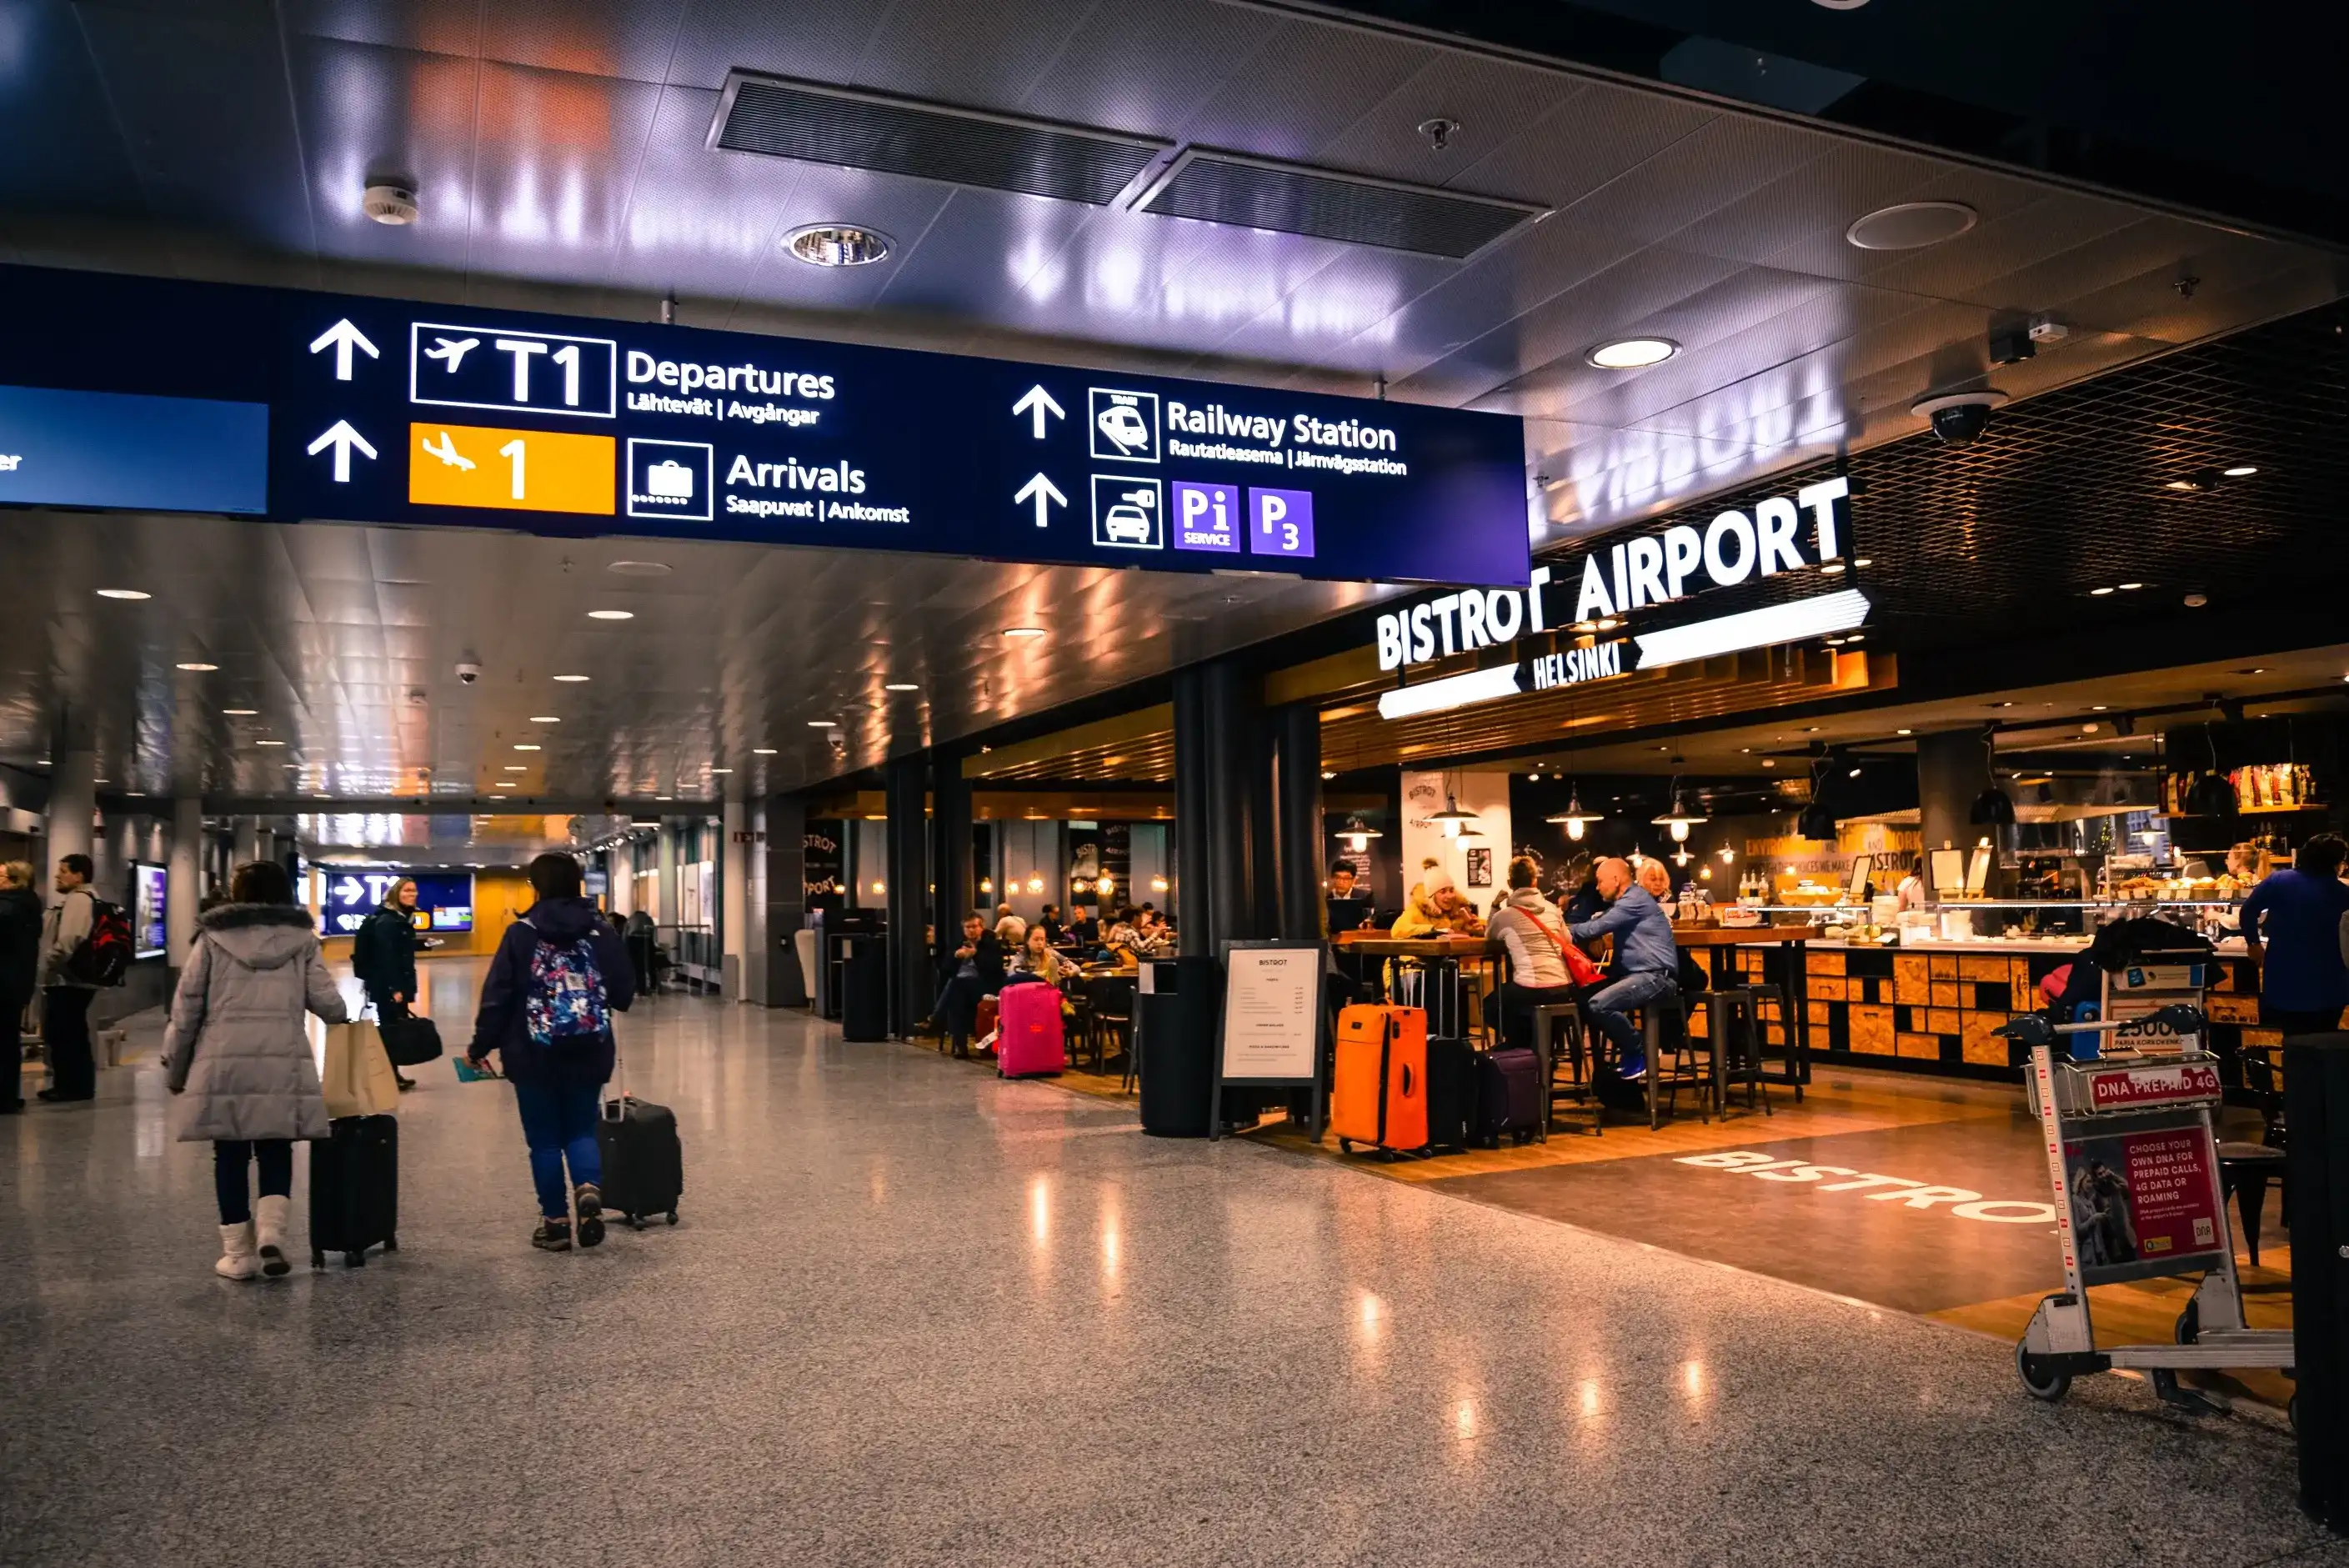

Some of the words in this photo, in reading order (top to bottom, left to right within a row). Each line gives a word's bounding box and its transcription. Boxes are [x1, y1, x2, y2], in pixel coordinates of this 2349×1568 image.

[496, 339, 579, 407] T1
[627, 351, 835, 399] Departures
[627, 392, 714, 416] Lähtevät
[728, 401, 820, 427] Avgångar
[1168, 401, 1287, 448] Railway
[1294, 414, 1396, 452] Station
[500, 440, 525, 500] 1
[725, 455, 866, 494] Arrivals
[1169, 439, 1284, 465] Rautatieasema
[1295, 451, 1407, 476] Järnvägsstation
[725, 495, 814, 518] Saapuvat
[828, 502, 910, 524] Ankomst
[1182, 488, 1230, 532] Pi
[1183, 531, 1231, 547] SERVICE
[1377, 566, 1550, 671] BISTROT
[1575, 476, 1849, 632] AIRPORT
[1533, 642, 1621, 691] HELSINKI
[2115, 1019, 2182, 1038] 2500
[2097, 1082, 2131, 1098] DNA
[2134, 1076, 2192, 1095] PREPAID
[2196, 1074, 2216, 1089] 4G
[2129, 1142, 2166, 1155] CHOOSE
[2168, 1139, 2191, 1150] YOUR
[2131, 1156, 2154, 1167] OWN
[2156, 1154, 2175, 1165] DNA
[2176, 1151, 2194, 1162] FOR
[2134, 1167, 2169, 1180] PREPAID
[2171, 1163, 2201, 1175] CALLS,
[2136, 1181, 2149, 1192] 4G
[2150, 1179, 2172, 1190] DATA
[2175, 1177, 2187, 1187] OR
[1672, 1151, 2057, 1235] BISTRO
[2137, 1191, 2180, 1205] ROAMING
